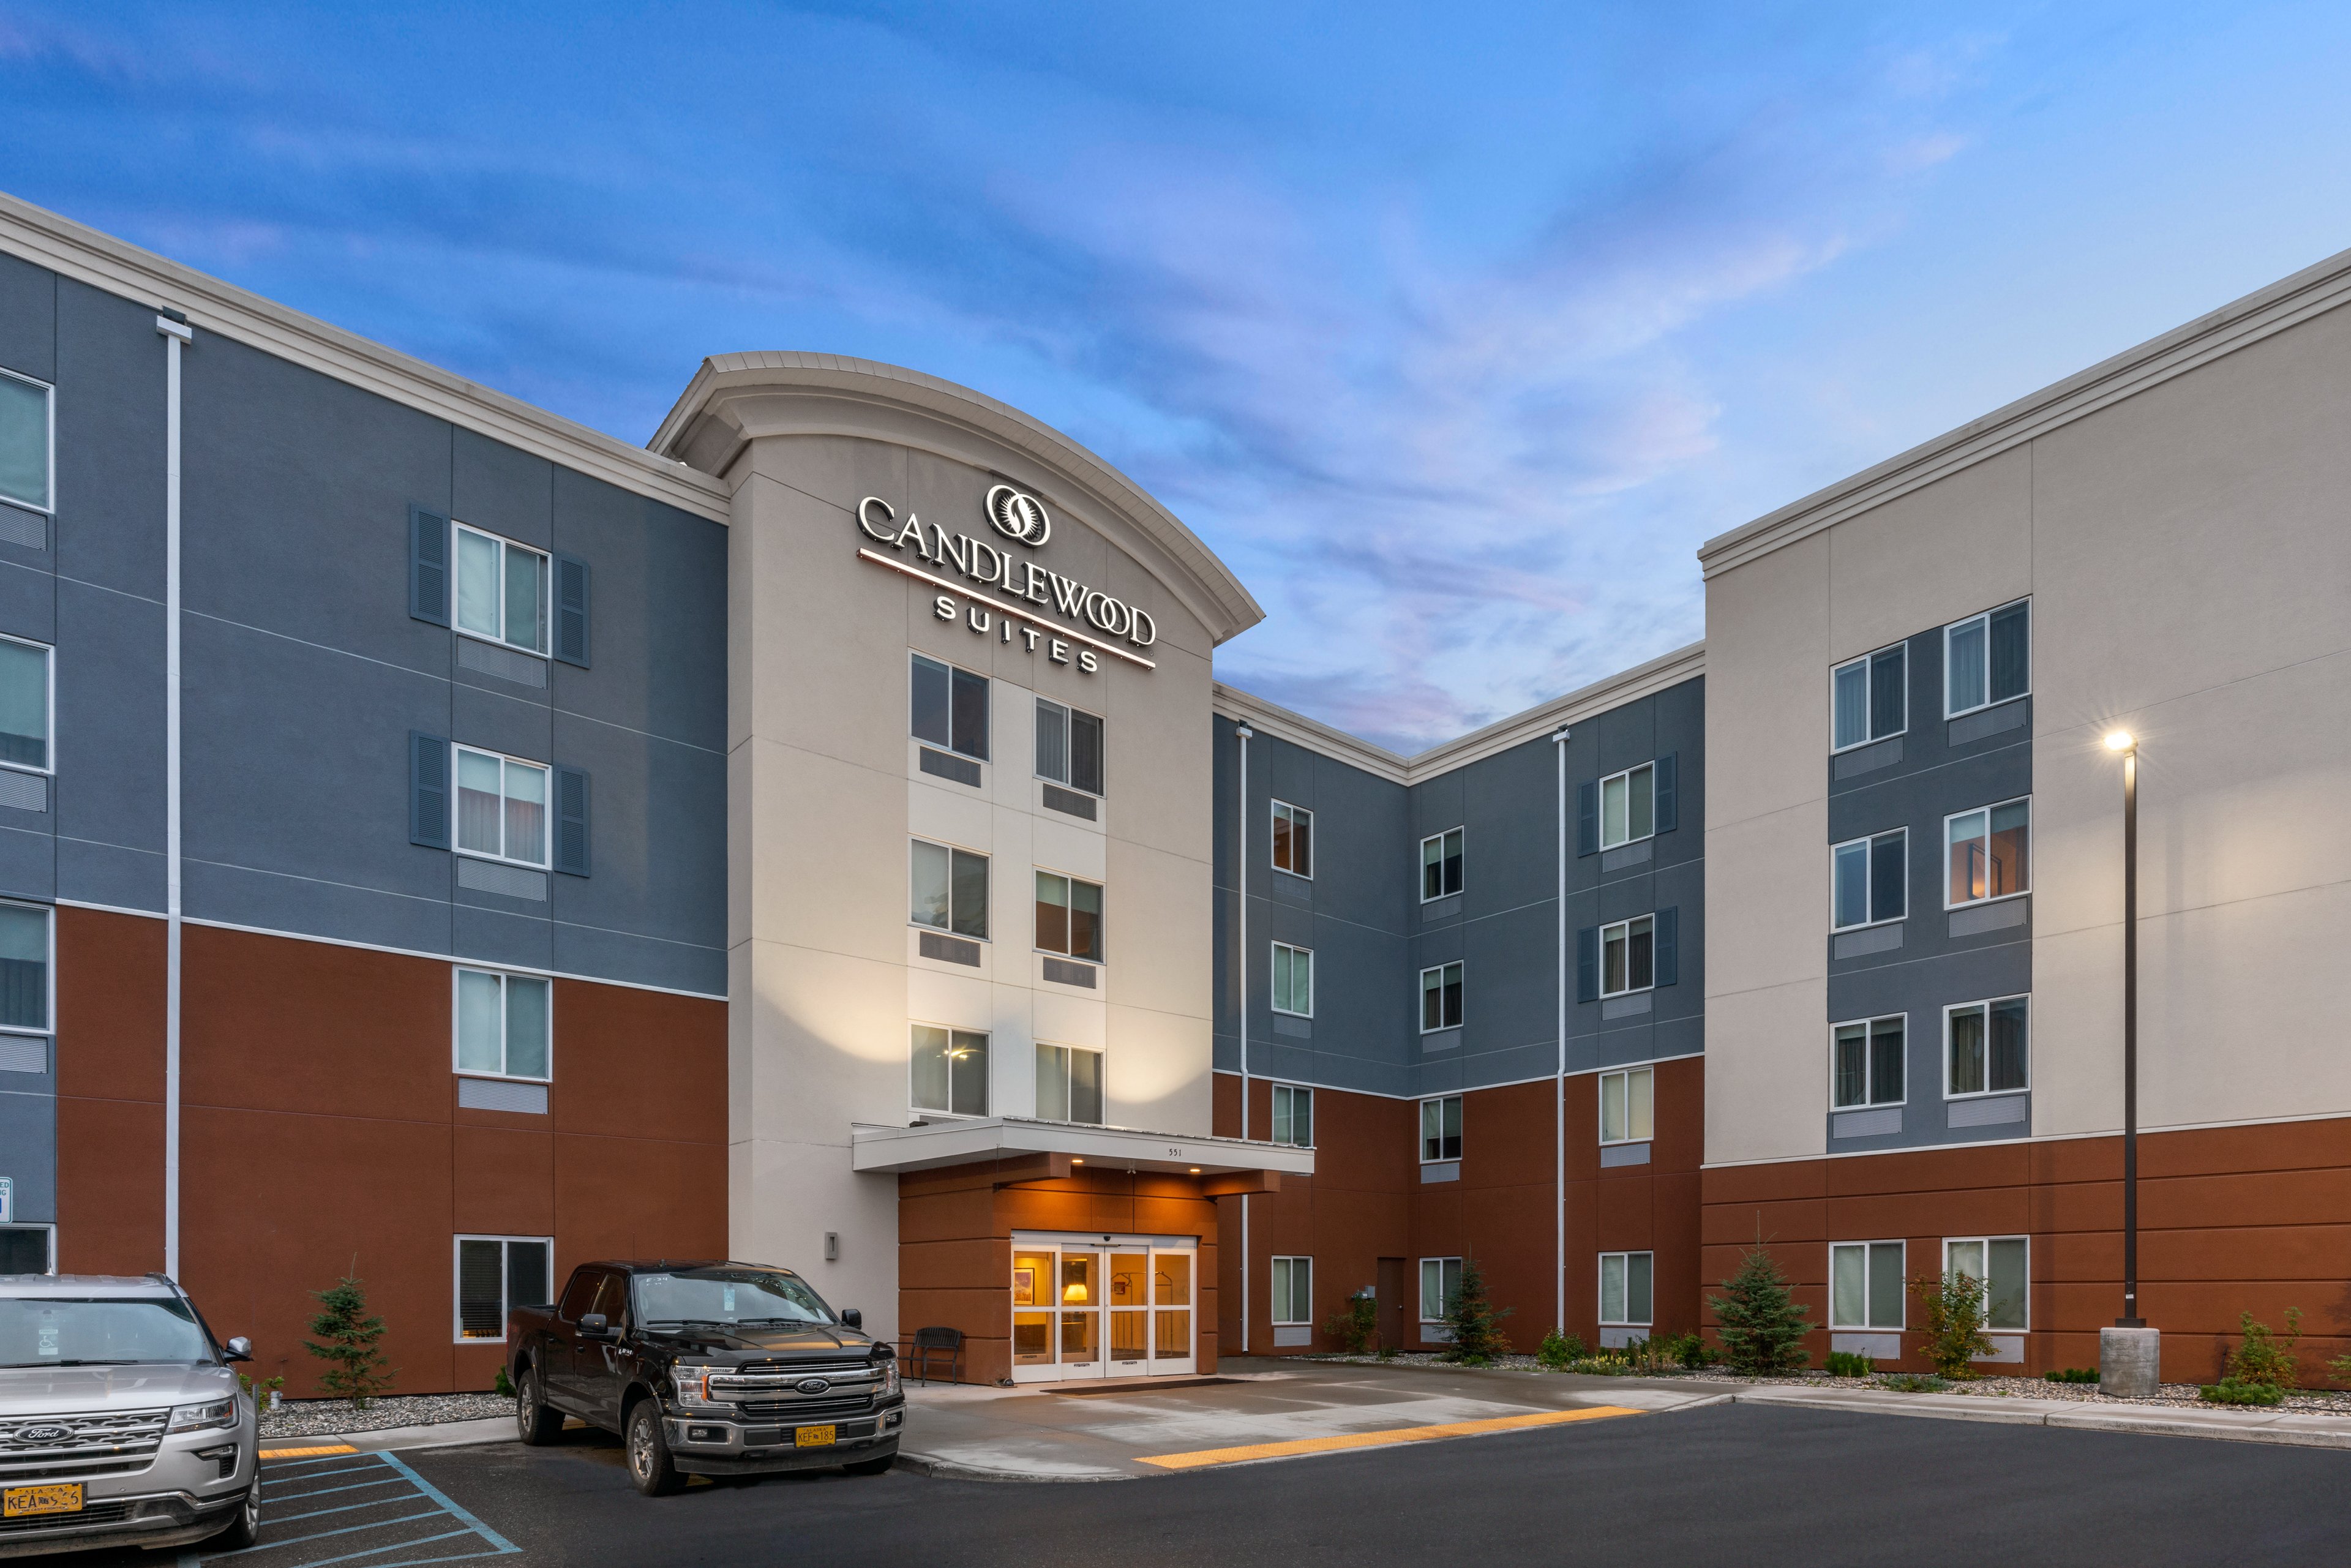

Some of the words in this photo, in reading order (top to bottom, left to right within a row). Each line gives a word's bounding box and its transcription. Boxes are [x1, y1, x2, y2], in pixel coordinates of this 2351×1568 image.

[856, 496, 1156, 647] CANDLEWOOD
[933, 596, 1098, 673] SUITES
[28, 1428, 59, 1438] Ford
[798, 1432, 812, 1442] KEF
[820, 1430, 833, 1440] 185
[8, 1495, 37, 1510] KEA
